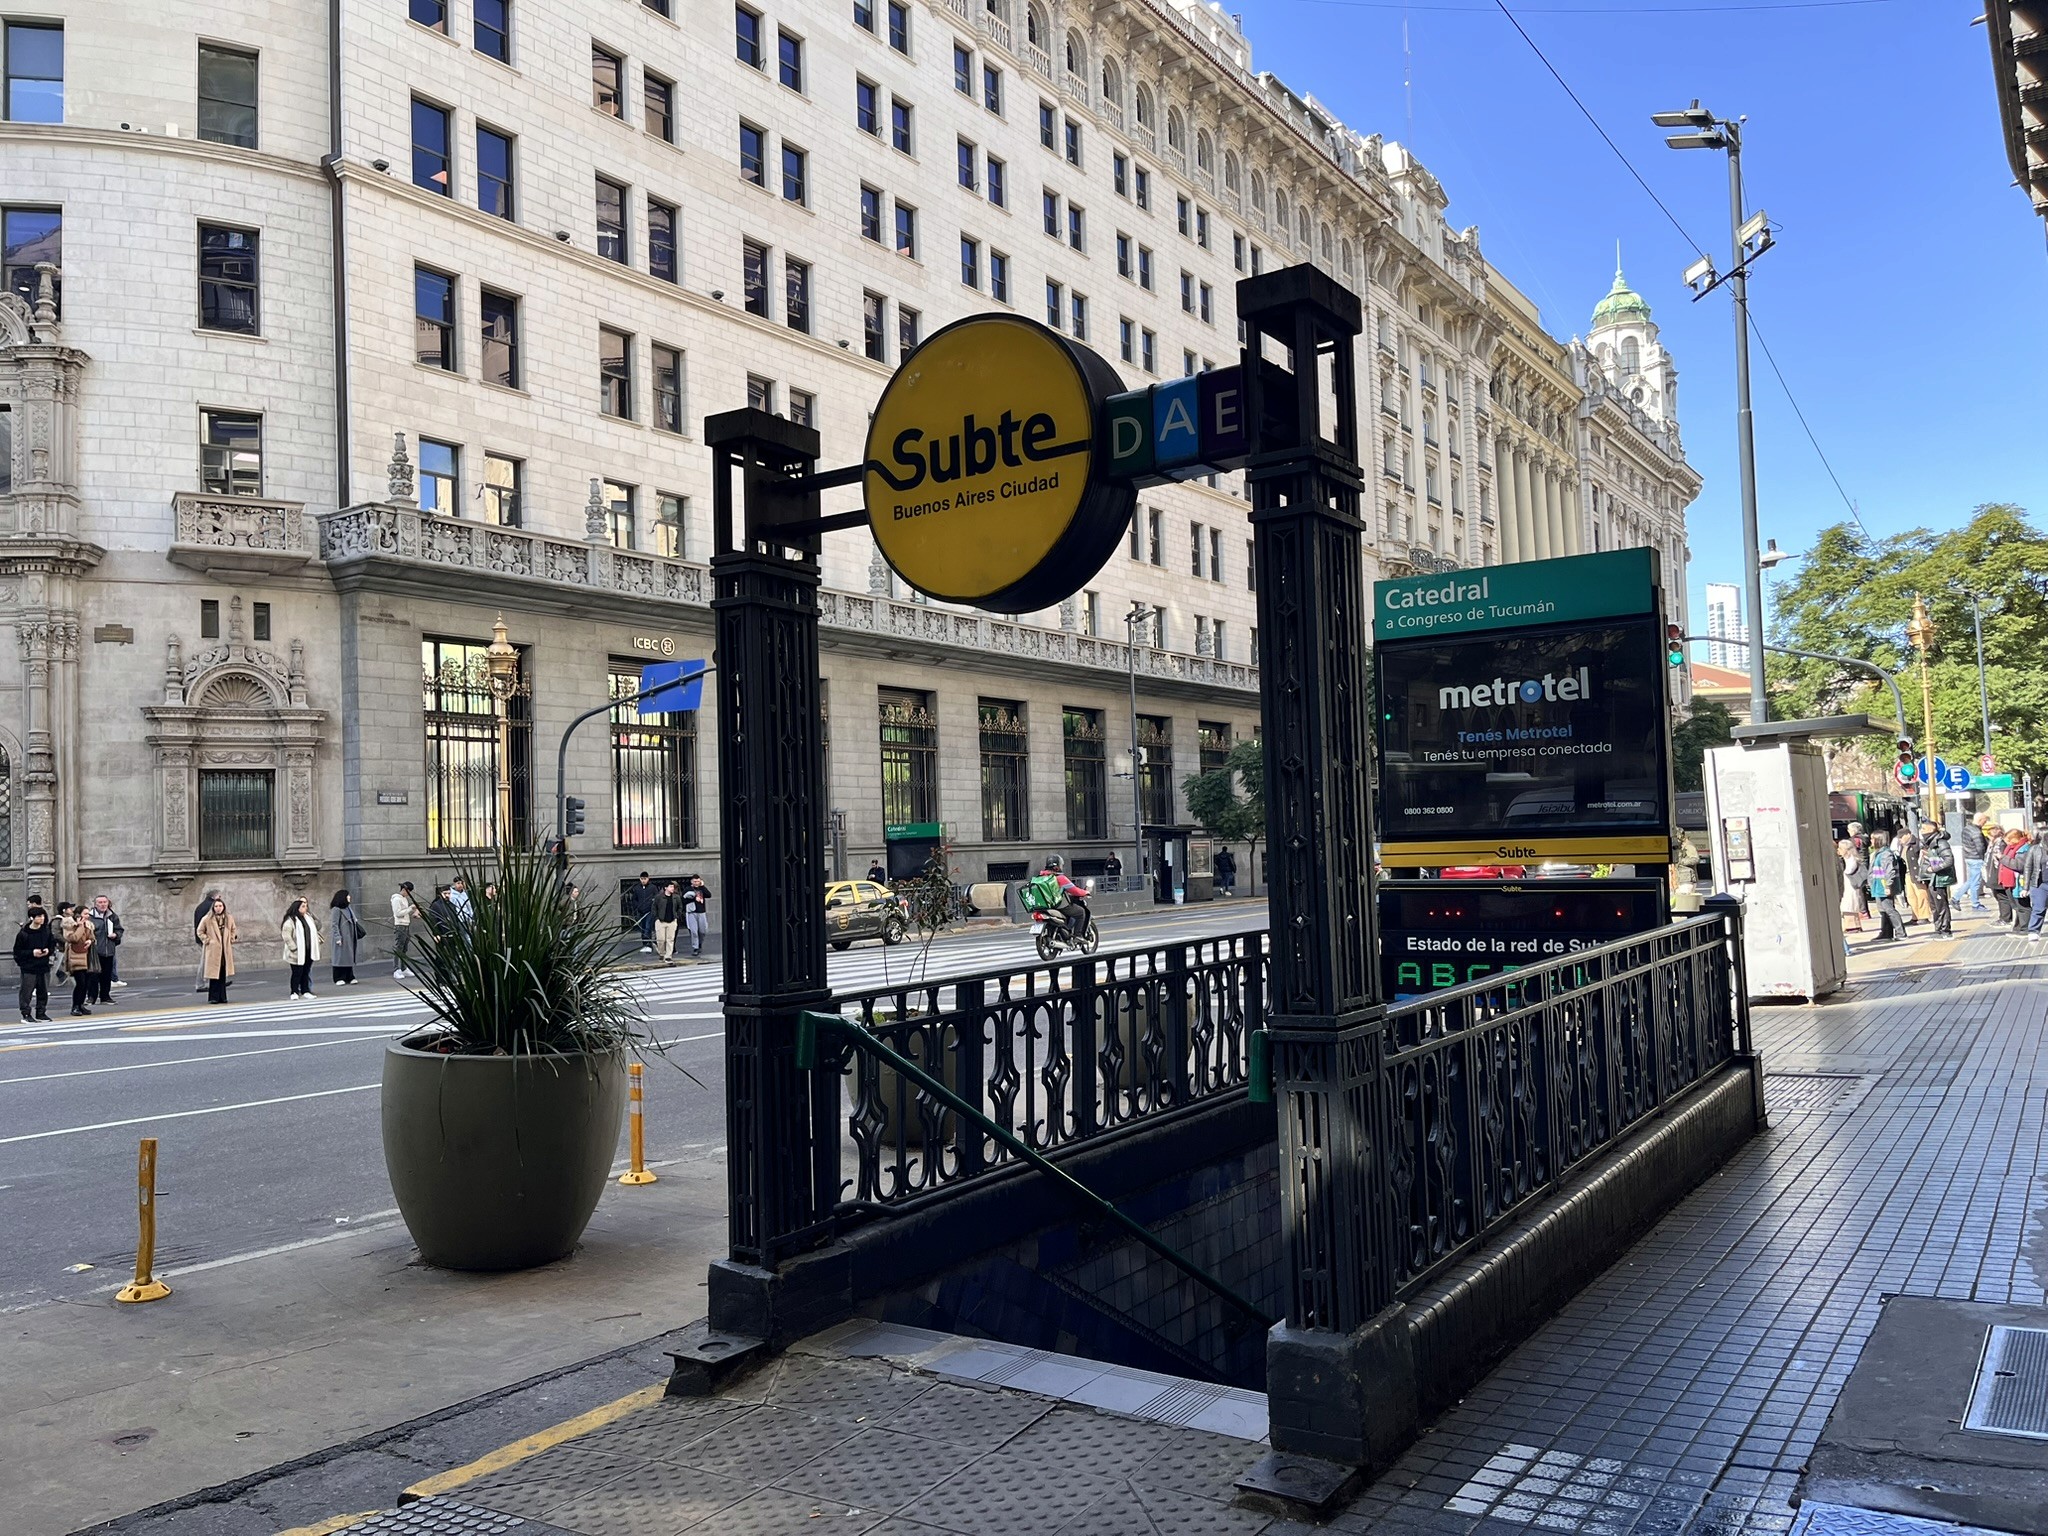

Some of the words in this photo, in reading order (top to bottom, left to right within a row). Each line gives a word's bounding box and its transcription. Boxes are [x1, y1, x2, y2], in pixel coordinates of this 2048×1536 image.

[1112, 416, 1142, 459] D
[1159, 398, 1196, 441] A
[1215, 389, 1238, 435] E
[891, 409, 1058, 491] Subte
[893, 499, 950, 520] Buenos
[955, 489, 995, 508] Aires
[1000, 472, 1059, 498] Ciudad
[1385, 576, 1489, 610] Catedral
[1386, 619, 1394, 629] a
[1398, 611, 1463, 629] Congreso
[1467, 607, 1485, 620] de
[1489, 600, 1555, 618] Tucumán
[633, 636, 659, 651] ICBC
[1439, 666, 1590, 710] metrotel
[1457, 729, 1503, 743] Tenés
[1506, 725, 1573, 741] Metrotel
[1424, 750, 1459, 762] Tenés
[1462, 749, 1475, 760] tu
[1477, 747, 1536, 761] empresa
[1539, 741, 1612, 756] conectada
[1404, 807, 1421, 815] 0800
[1498, 846, 1536, 858] Subte
[1407, 937, 1462, 951] Estado
[1466, 938, 1487, 952] de
[1491, 938, 1506, 952] la
[1511, 938, 1538, 953] red
[1543, 939, 1565, 953] de
[1398, 962, 1421, 986] A
[1432, 963, 1456, 987] B
